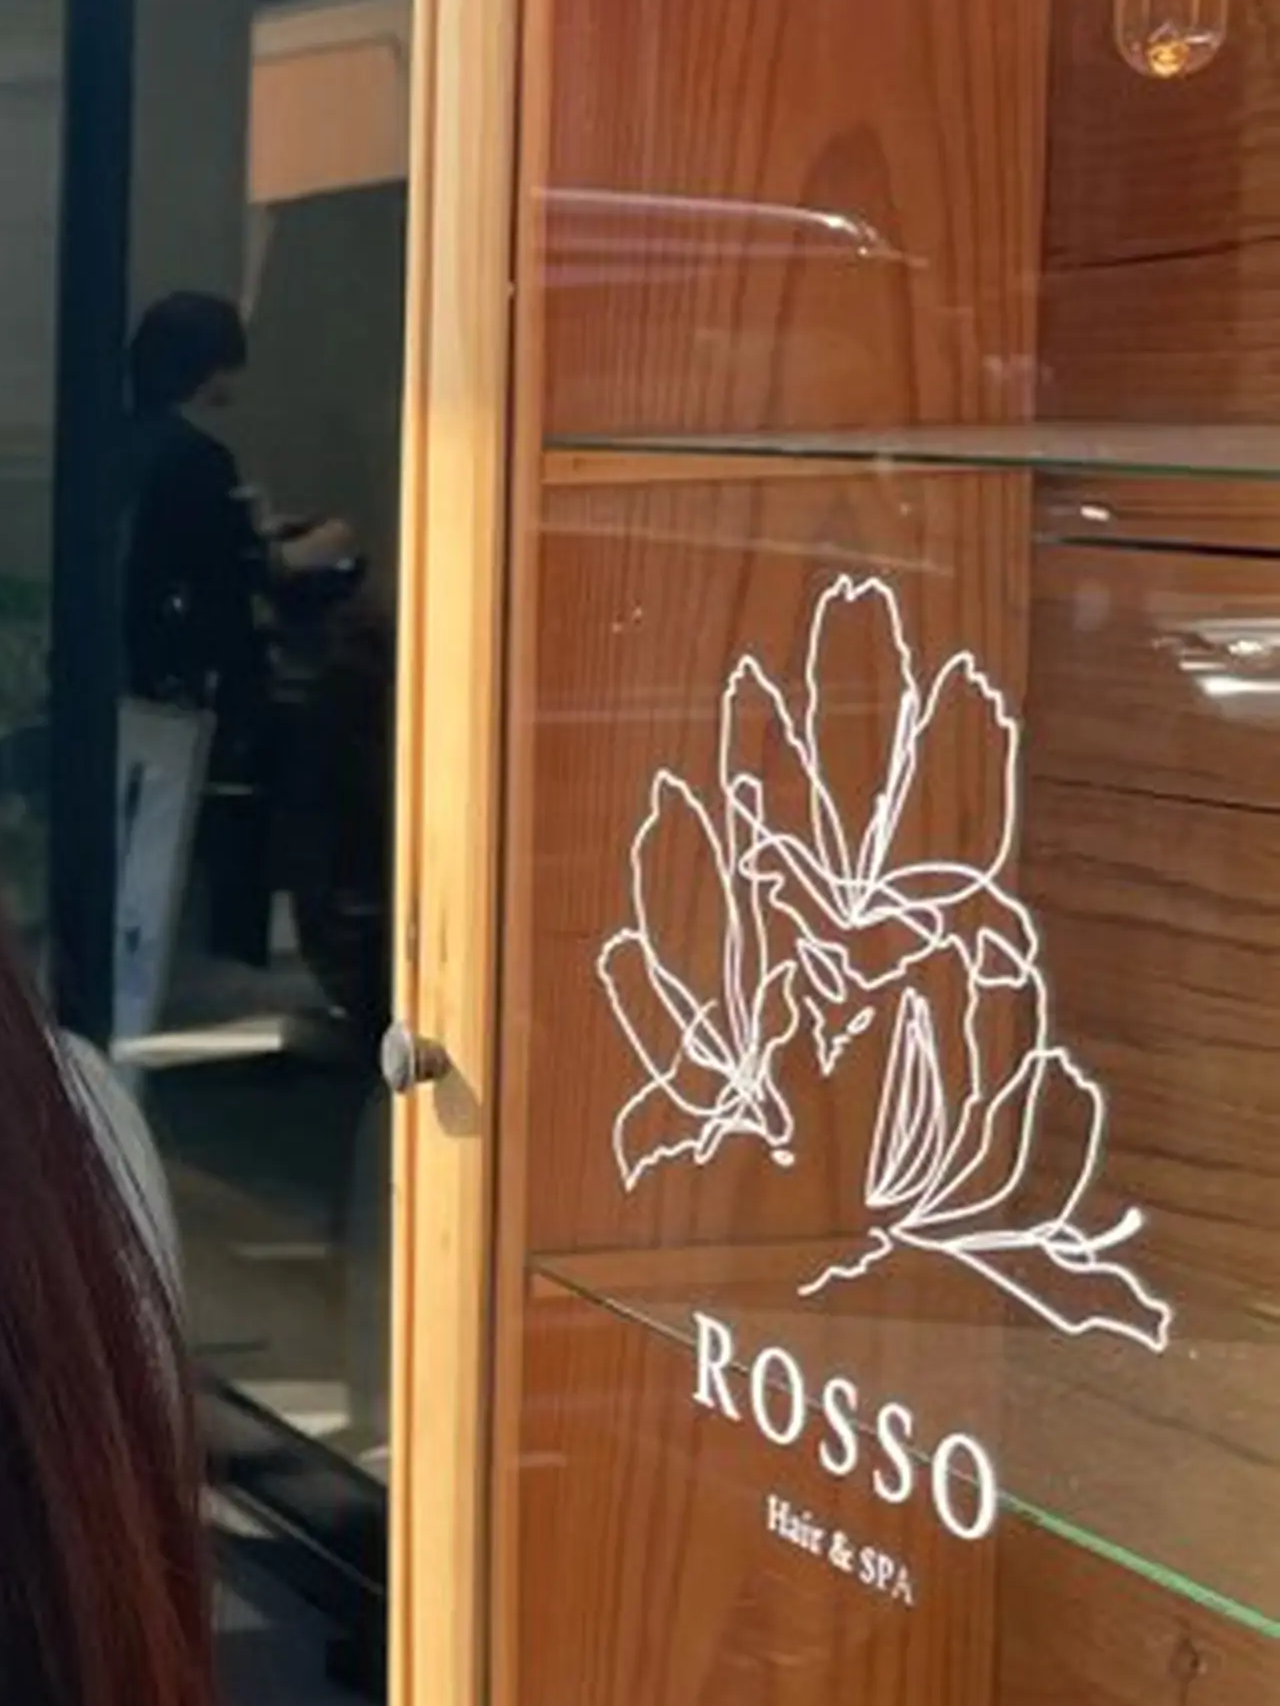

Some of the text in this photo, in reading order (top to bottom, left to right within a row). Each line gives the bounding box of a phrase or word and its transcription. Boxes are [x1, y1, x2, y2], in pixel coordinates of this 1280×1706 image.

[692, 1311, 999, 1541] ROSSO
[766, 1495, 916, 1606] Hair & SPA
